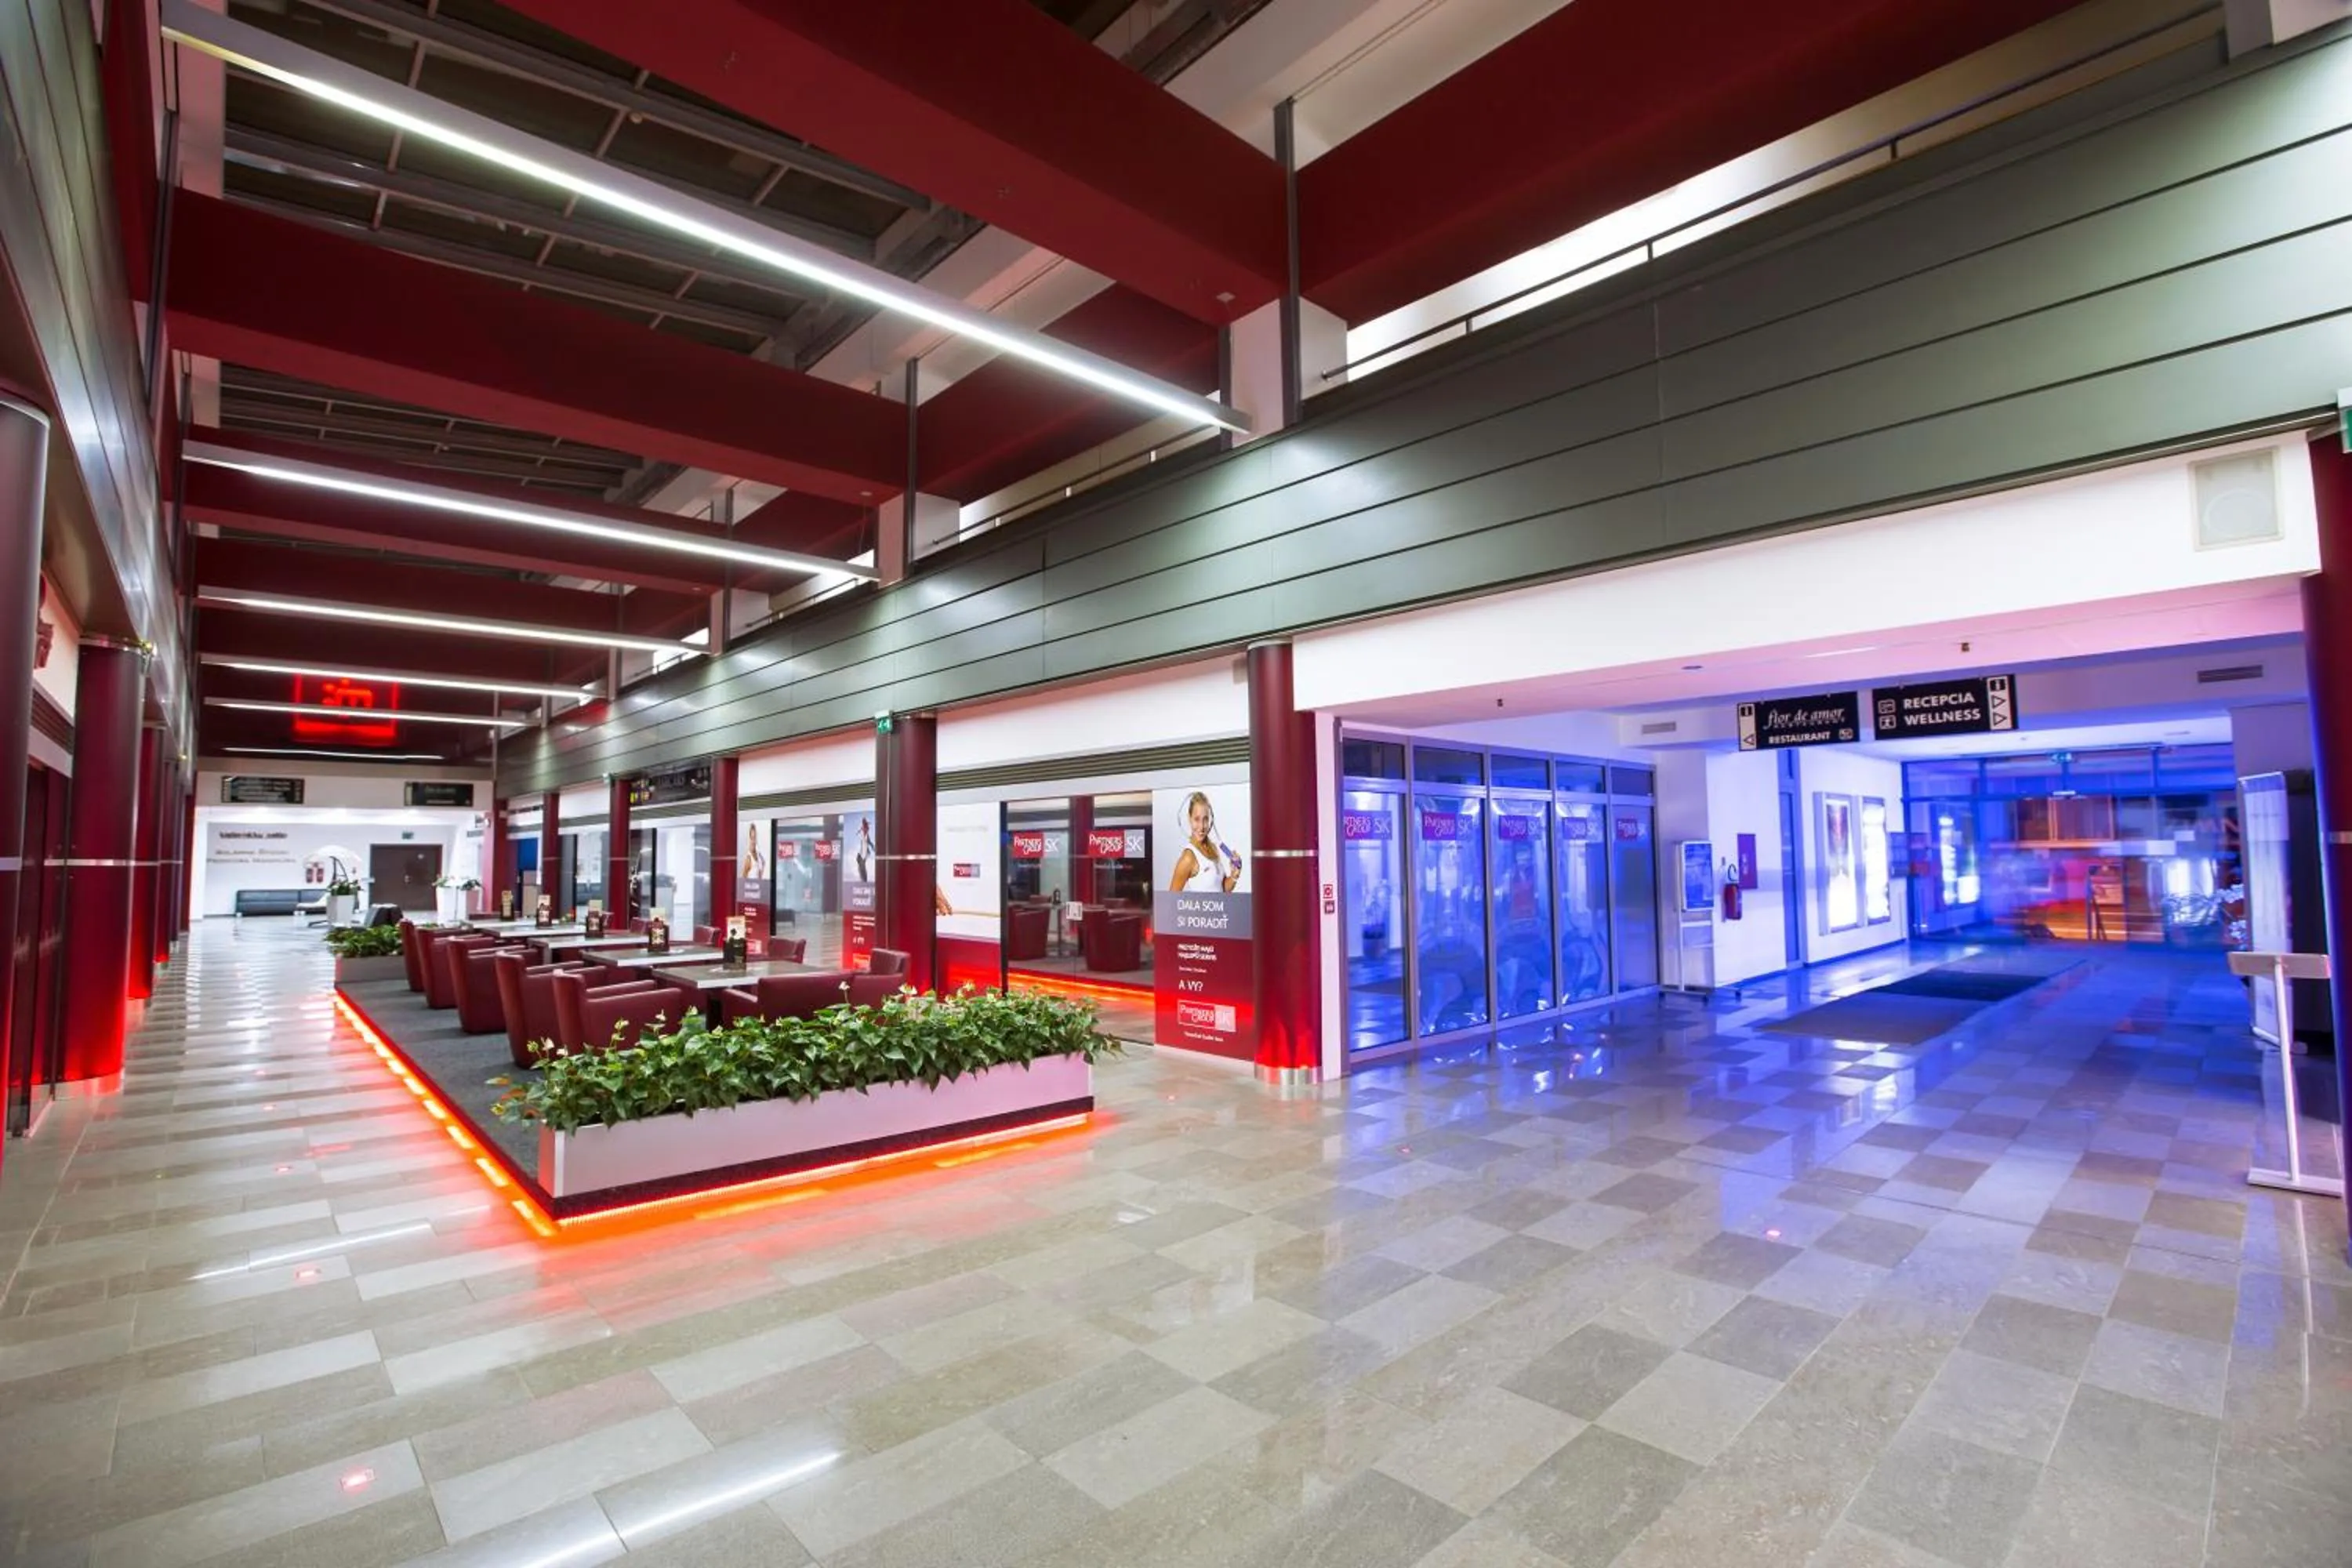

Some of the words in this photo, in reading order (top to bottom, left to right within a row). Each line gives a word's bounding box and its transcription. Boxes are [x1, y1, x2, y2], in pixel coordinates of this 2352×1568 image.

[1903, 692, 1975, 710] RECEPCIA
[1793, 709, 1806, 721] de
[1810, 708, 1845, 721] amor
[1904, 709, 1981, 726] WELLNESS
[1769, 731, 1831, 744] RESTAURANT
[1044, 838, 1060, 852] SK
[1126, 835, 1143, 851] SK
[1177, 899, 1200, 911] DALA
[1203, 900, 1224, 912] SOM
[1178, 916, 1185, 927] SI
[1187, 914, 1229, 929] PORADIŤ
[1178, 979, 1185, 990] A
[1188, 981, 1203, 992] VY?
